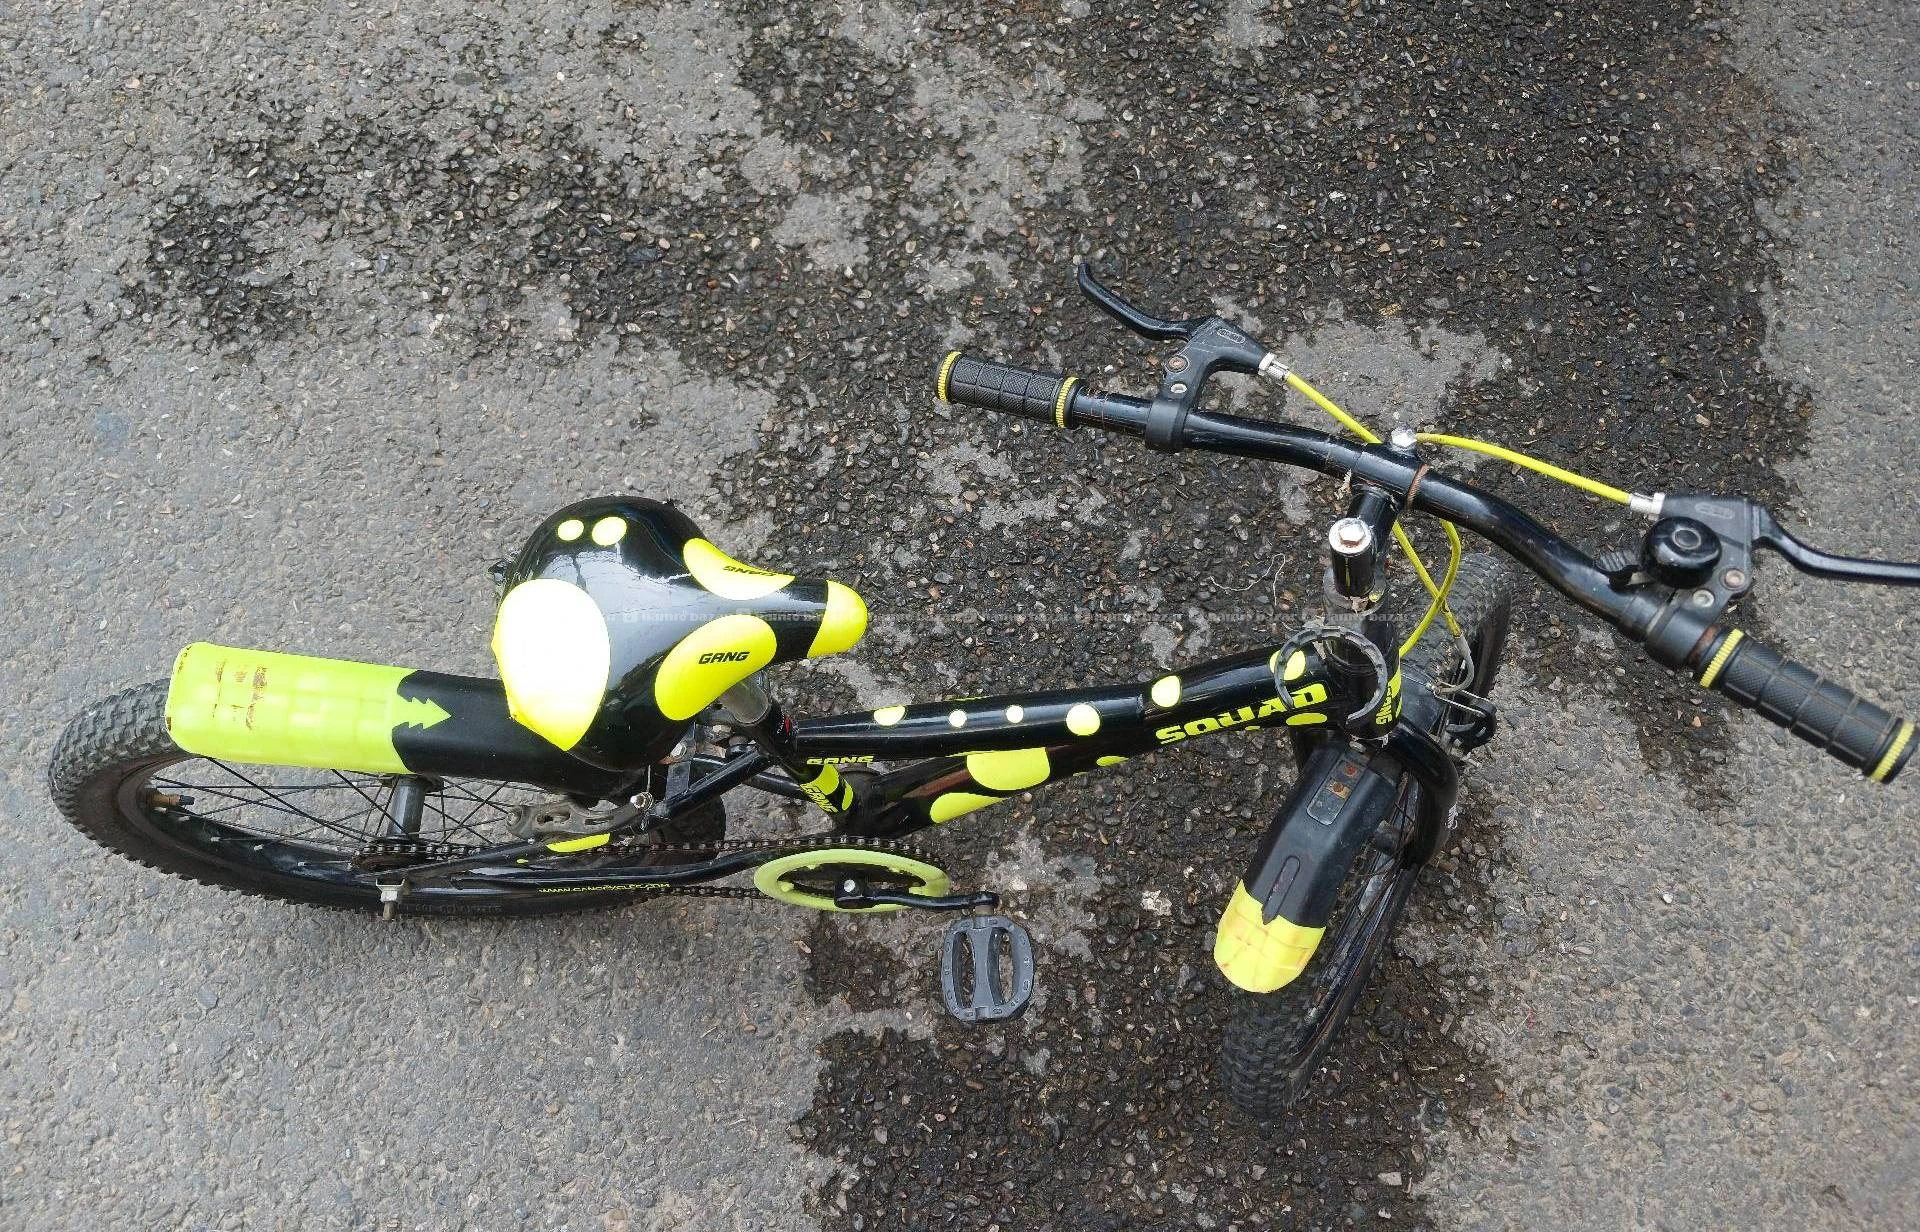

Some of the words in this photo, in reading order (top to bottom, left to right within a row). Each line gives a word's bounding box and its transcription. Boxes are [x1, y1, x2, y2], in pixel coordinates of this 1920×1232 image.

[698, 651, 751, 665] GANG
[1155, 683, 1329, 745] SQUAD
[806, 754, 875, 765] GANG
